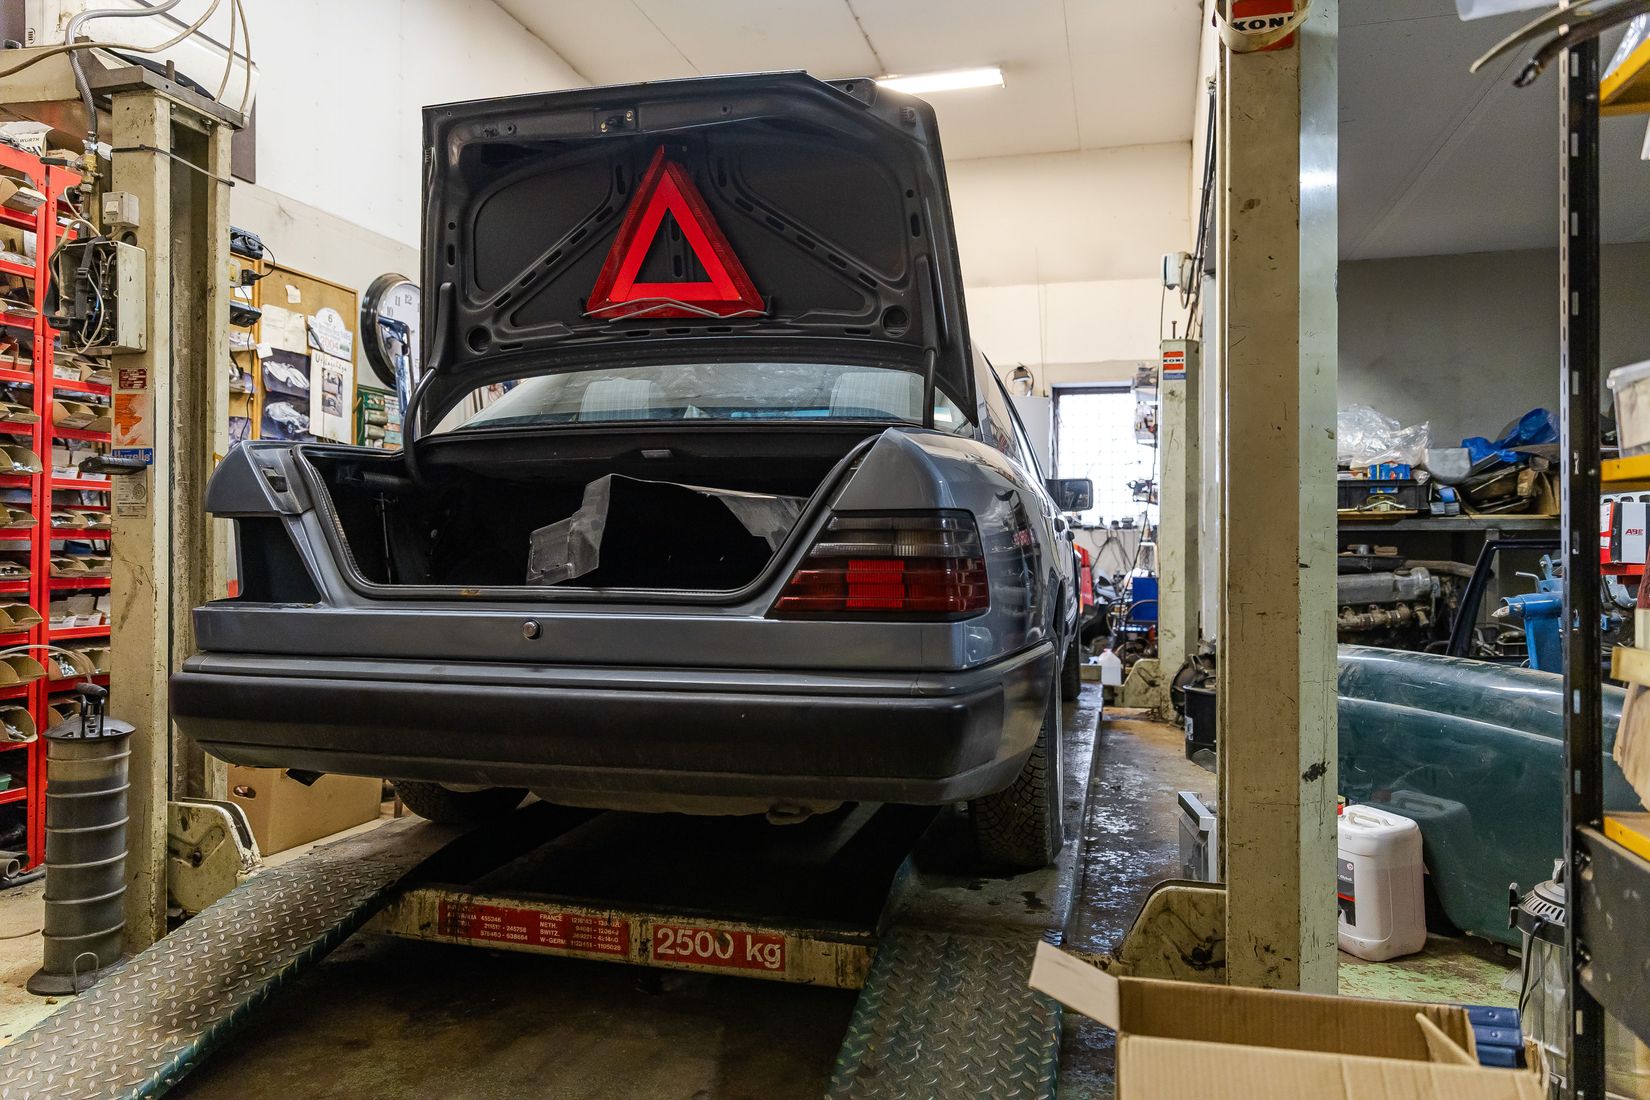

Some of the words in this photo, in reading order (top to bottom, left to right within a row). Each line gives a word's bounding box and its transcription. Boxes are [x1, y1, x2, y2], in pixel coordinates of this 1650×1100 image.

[395, 296, 401, 307] 11
[404, 294, 412, 304] 12
[386, 306, 394, 317] 10
[327, 314, 333, 322] 6
[539, 913, 563, 922] FRANCE
[539, 921, 558, 929] NETH.
[539, 928, 560, 937] SWITZ.
[656, 927, 735, 960] 2500
[745, 934, 781, 969] kg
